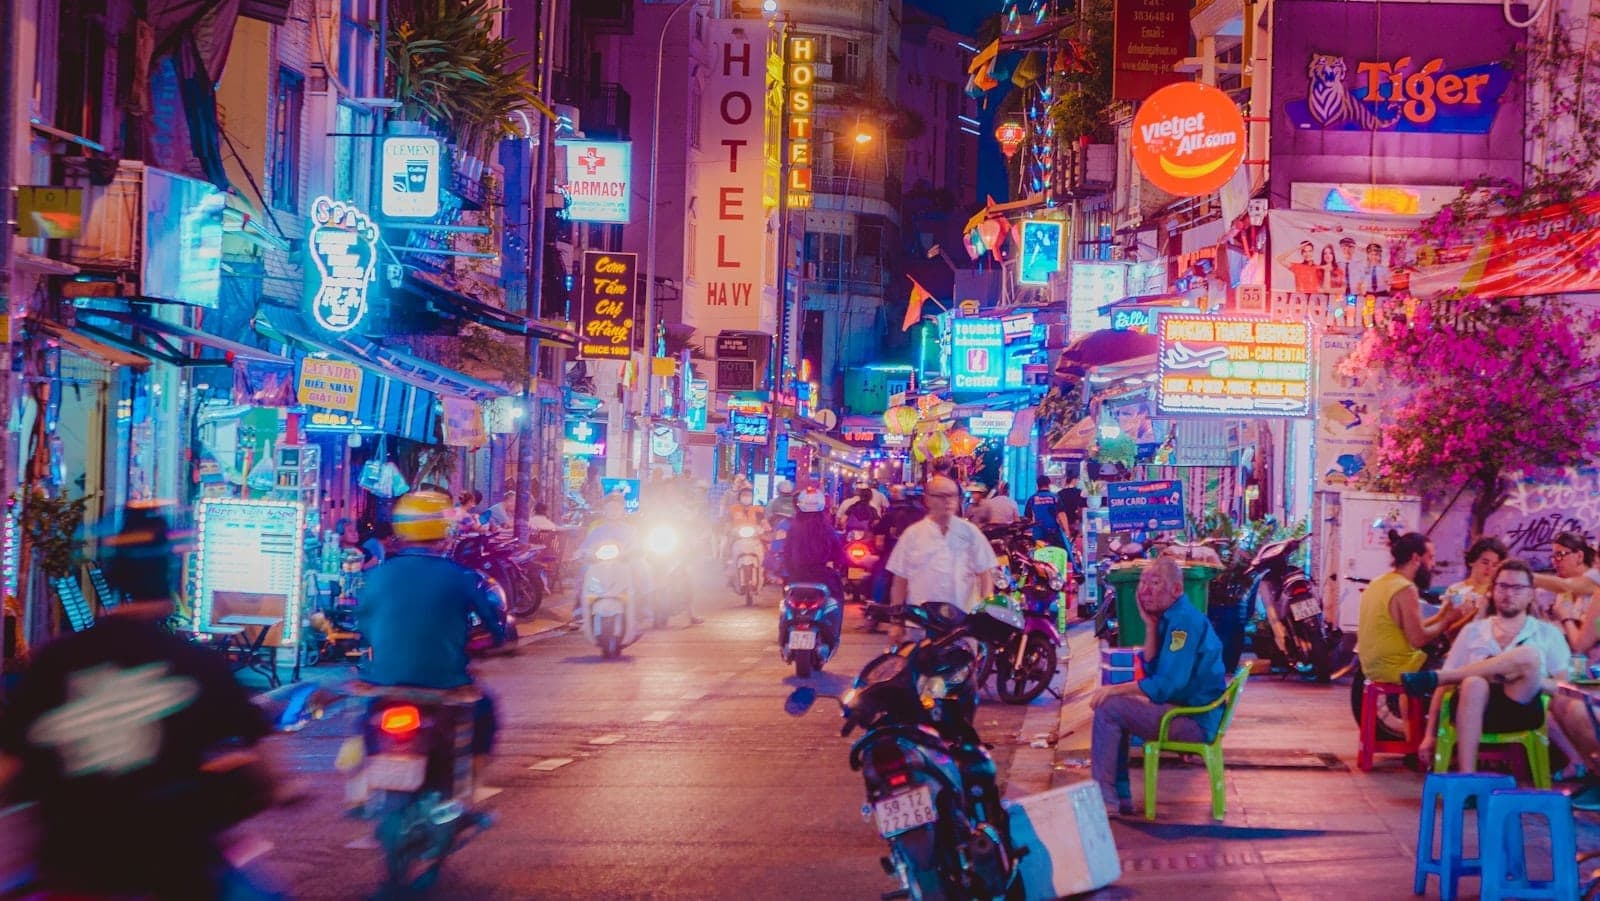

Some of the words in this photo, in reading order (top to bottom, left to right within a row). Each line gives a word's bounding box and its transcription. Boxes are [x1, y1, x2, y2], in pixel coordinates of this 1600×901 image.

[1357, 56, 1490, 123] Tiger
[793, 40, 812, 189] HOSTEL
[718, 43, 752, 268] HOTEL
[1242, 288, 1260, 302] 55
[955, 324, 1001, 335] TOURIST
[584, 345, 609, 354] SINCE
[1325, 341, 1350, 349] DAILY
[1229, 345, 1249, 360] VISA
[1255, 346, 1272, 361] CAR
[956, 375, 999, 387] Center
[1111, 499, 1125, 507] SIM
[1126, 497, 1147, 505] CARD
